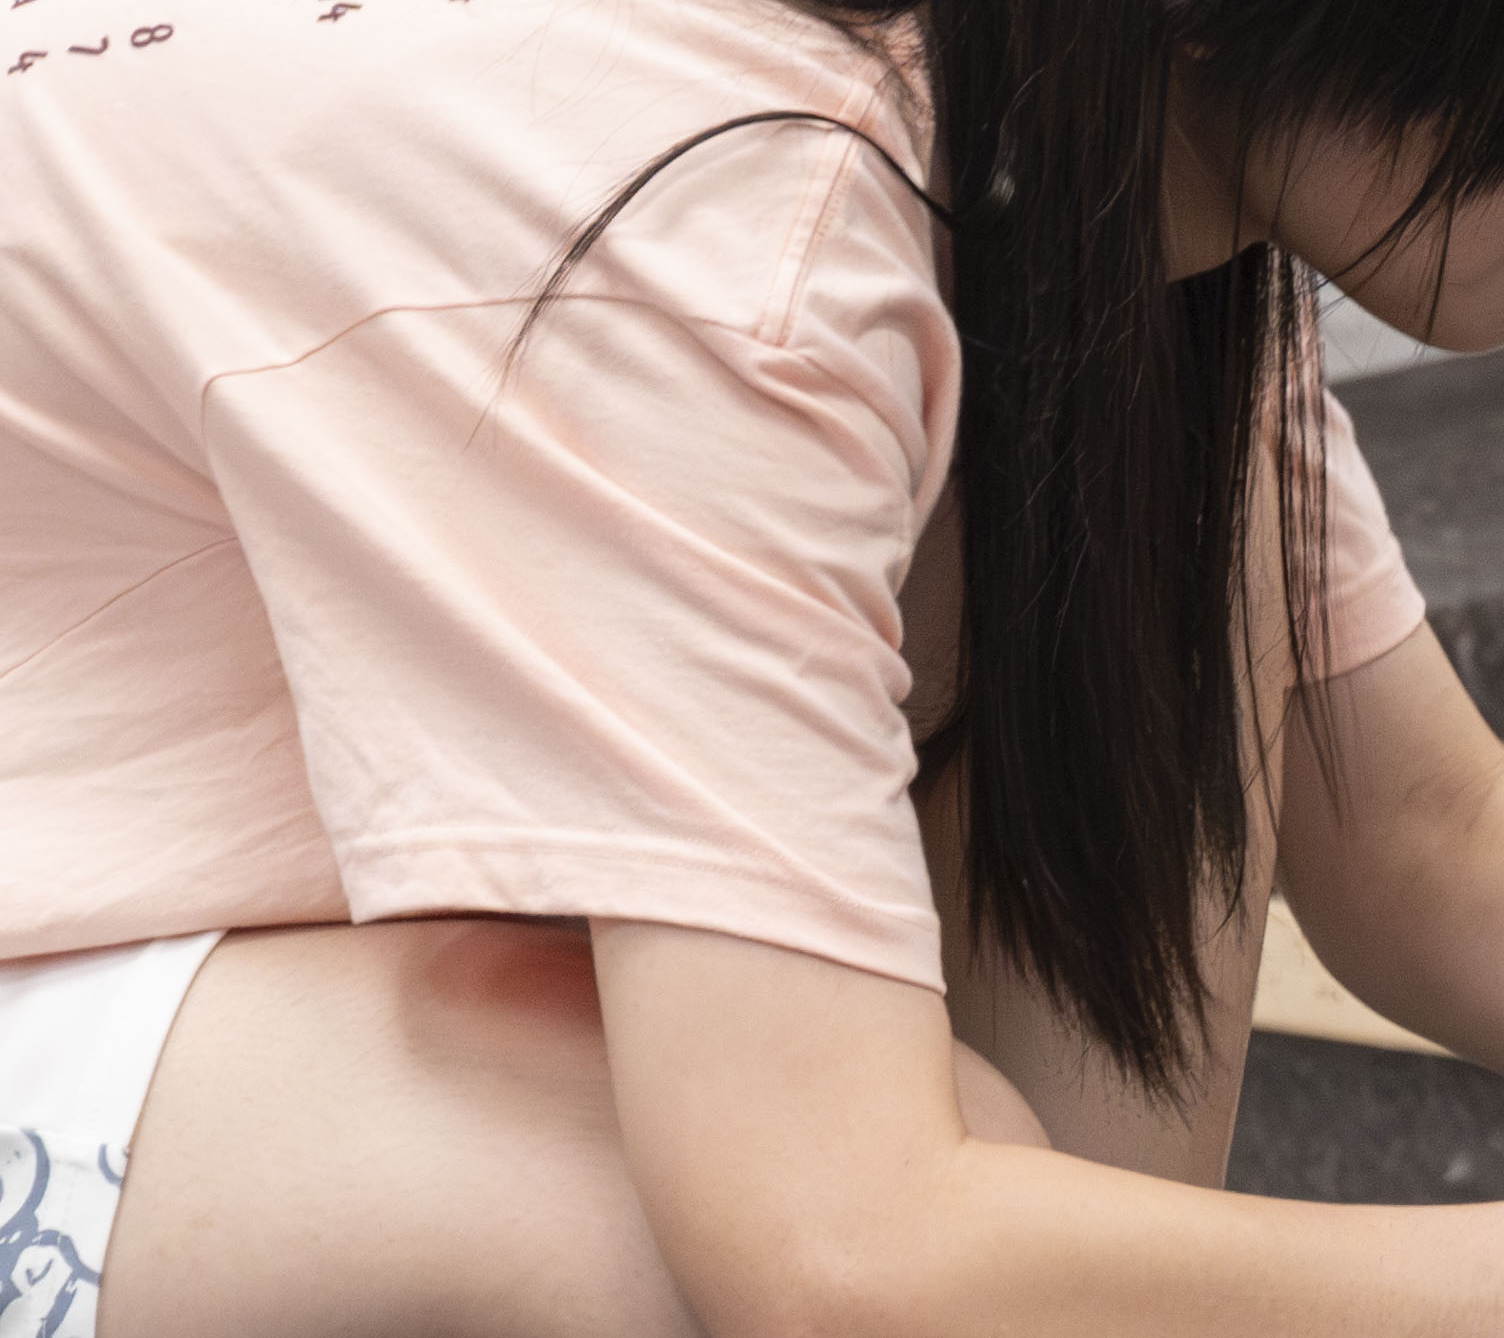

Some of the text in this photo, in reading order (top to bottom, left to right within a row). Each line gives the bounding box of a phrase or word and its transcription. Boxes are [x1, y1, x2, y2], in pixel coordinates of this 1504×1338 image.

[68, 35, 110, 55] 7
[130, 23, 174, 48] 8
[6, 50, 49, 75] 4
